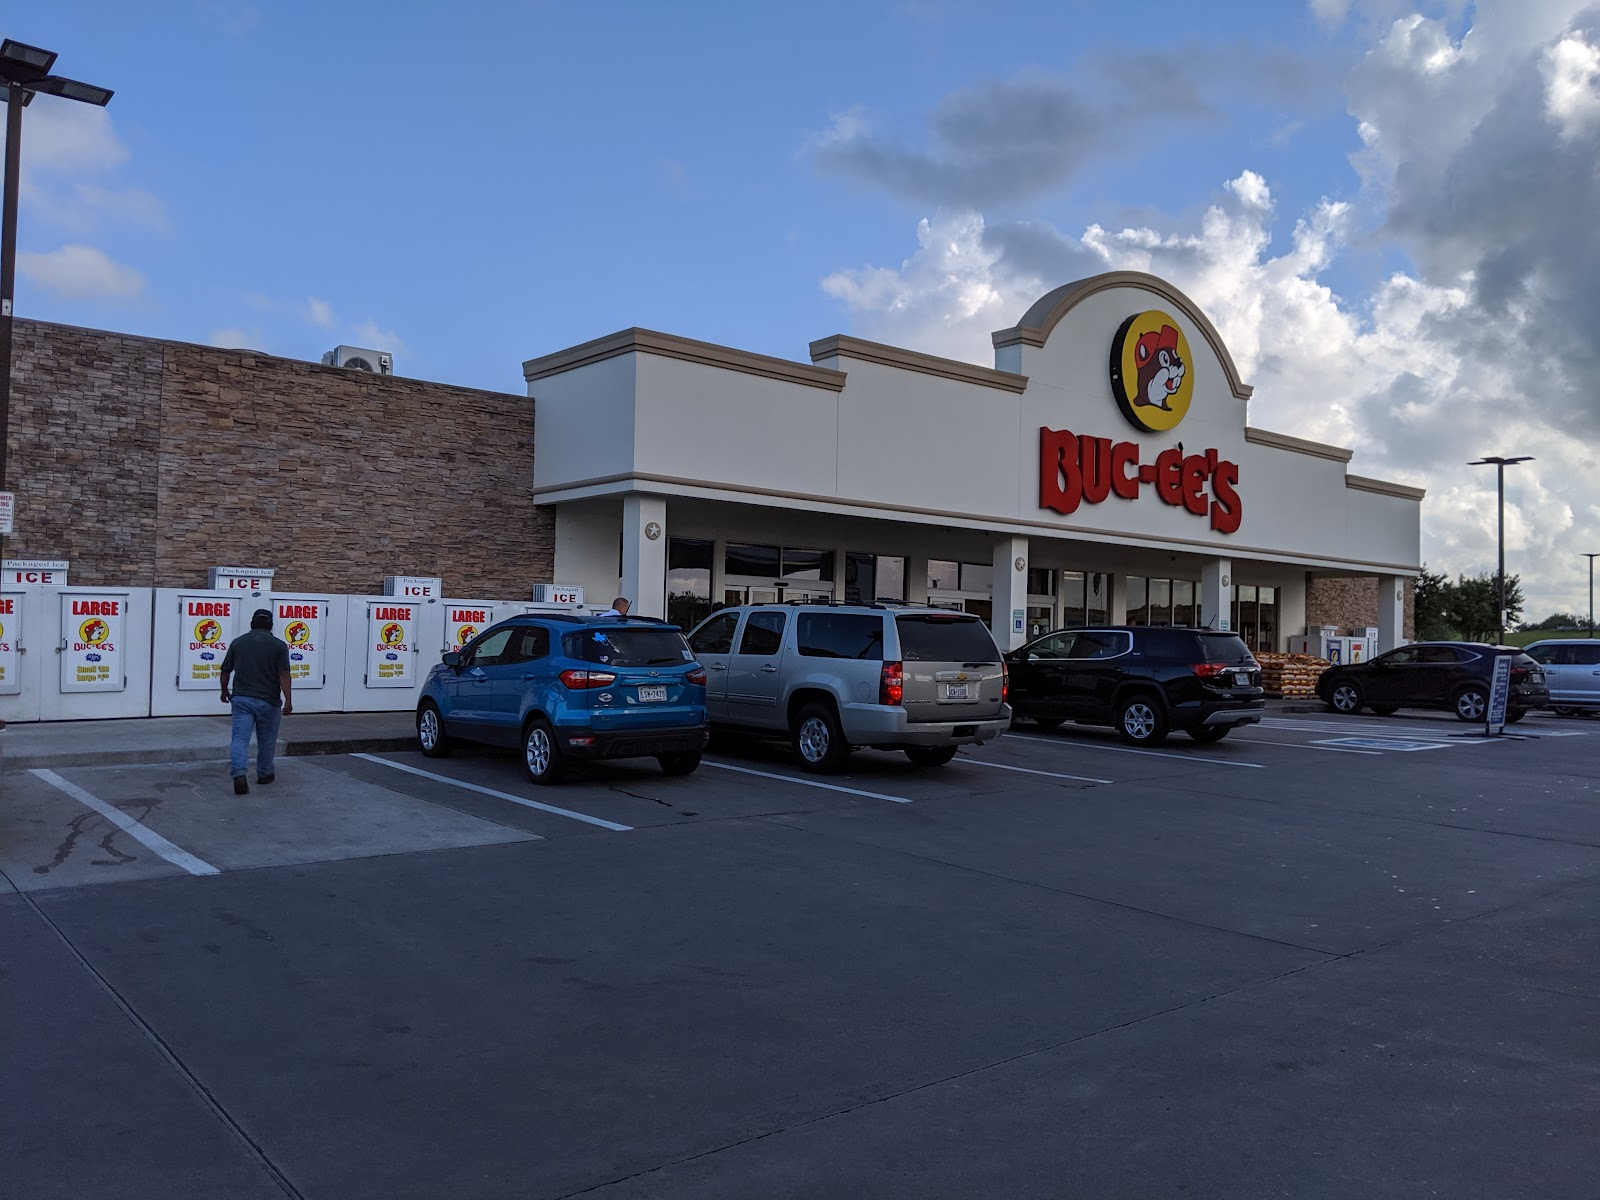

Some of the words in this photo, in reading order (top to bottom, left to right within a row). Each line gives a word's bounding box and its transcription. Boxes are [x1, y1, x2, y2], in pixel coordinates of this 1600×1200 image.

[7, 561, 50, 569] Packaged
[16, 572, 53, 584] ICE
[229, 578, 260, 590] ICE
[405, 586, 431, 597] ICE
[553, 593, 577, 603] ICE
[72, 600, 119, 616] LARGE
[188, 602, 231, 617] LARGE
[279, 605, 318, 619] LARGE
[375, 607, 411, 620] LARGE
[452, 610, 486, 623] LARGE
